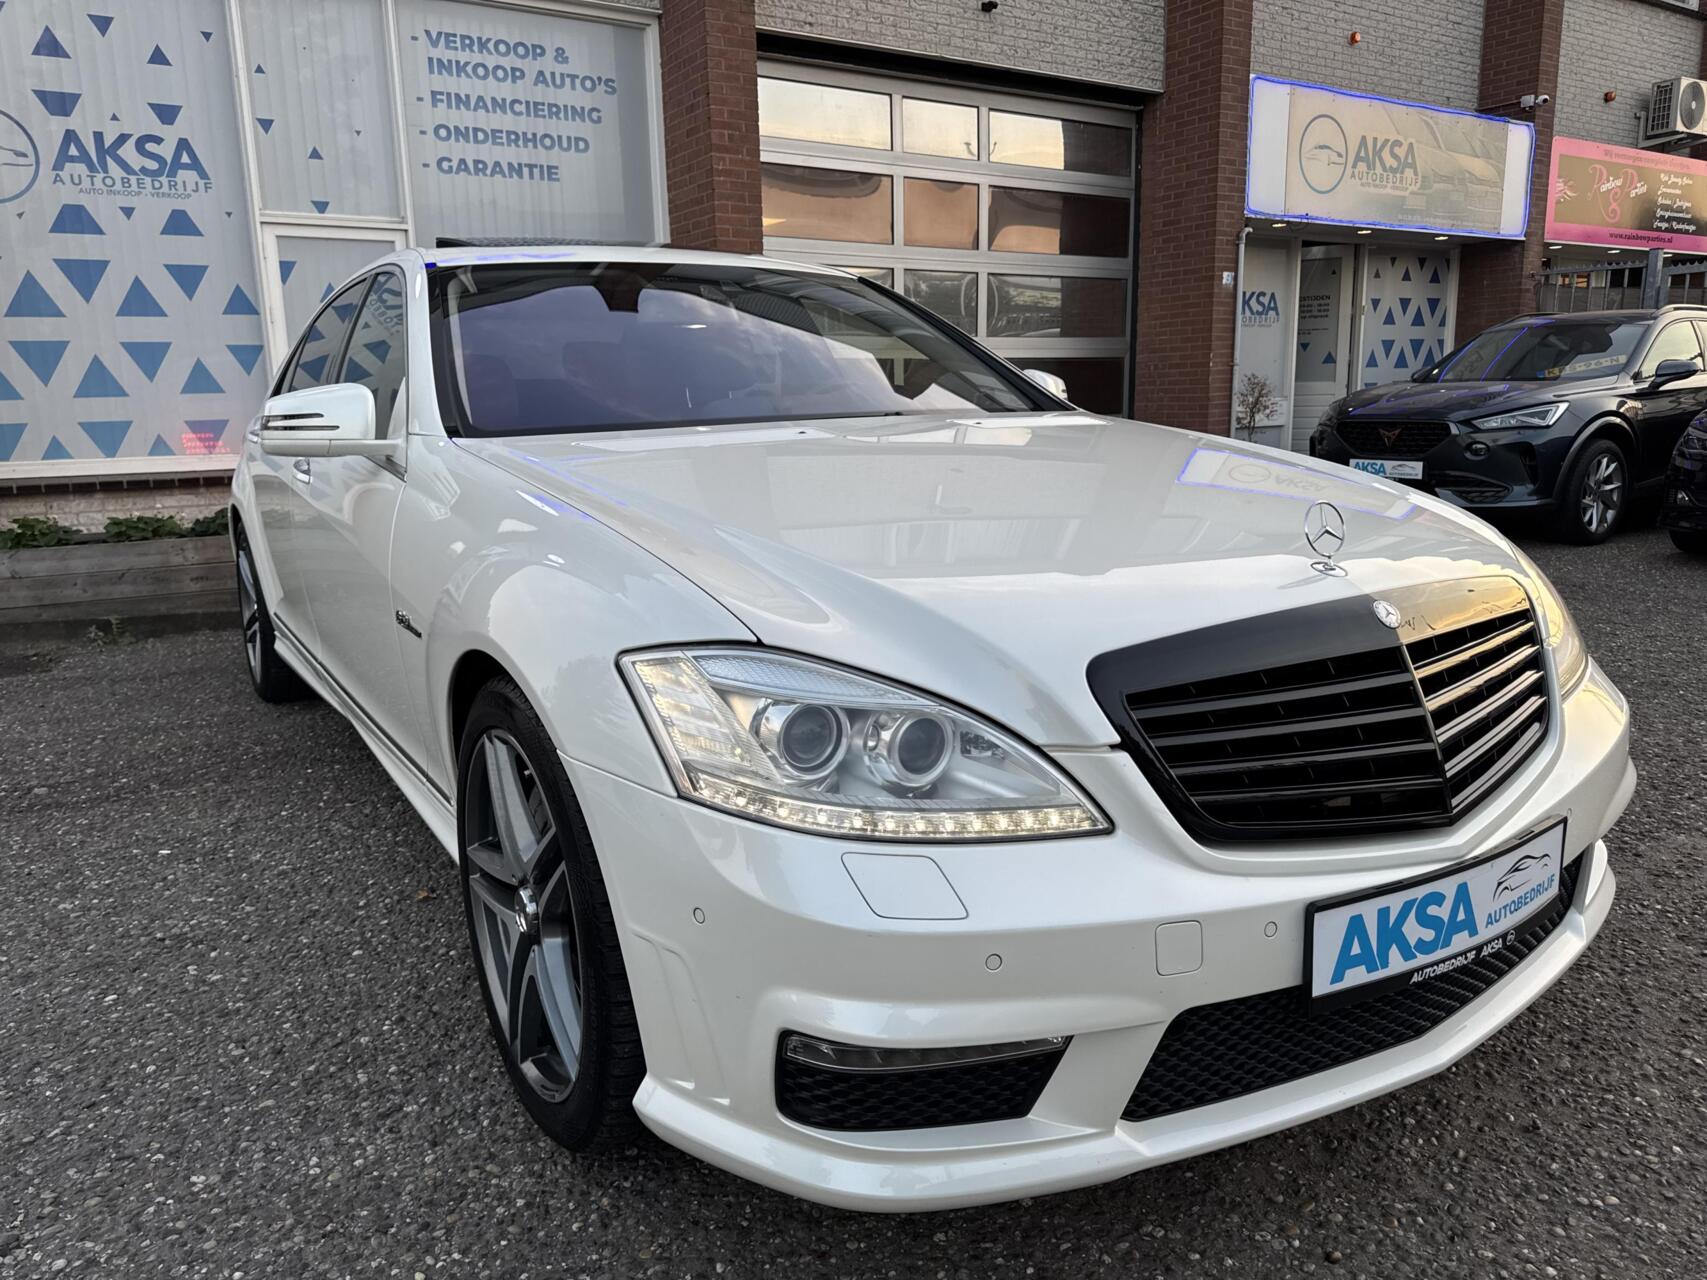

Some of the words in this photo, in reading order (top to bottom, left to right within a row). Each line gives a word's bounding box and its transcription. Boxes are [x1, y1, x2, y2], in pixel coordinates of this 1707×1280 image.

[424, 29, 546, 61] VERKOOP
[553, 46, 570, 65] &
[427, 56, 526, 84] INKOOP
[533, 69, 618, 96] AUTO'S
[430, 89, 603, 125] FINANCIERING
[51, 128, 211, 181] AKSA
[433, 123, 590, 154] ONDERHOUD
[1351, 134, 1419, 176] AKSA
[52, 172, 214, 193] AUTOBEDRIJF
[436, 156, 561, 182] GARANTIE
[1350, 169, 1420, 187] AUTOBEDRIJF
[78, 187, 104, 196] AUTO
[106, 188, 143, 198] INKOOP
[151, 191, 192, 200] VERKOOP
[1241, 291, 1280, 316] KSA
[1354, 461, 1387, 476] AKSA
[1329, 881, 1479, 986] AKSA
[1485, 873, 1556, 929] AUTOBEDRIJF
[1409, 950, 1477, 985] AUTOBEDRIJF
[1480, 938, 1503, 958] AKSA
